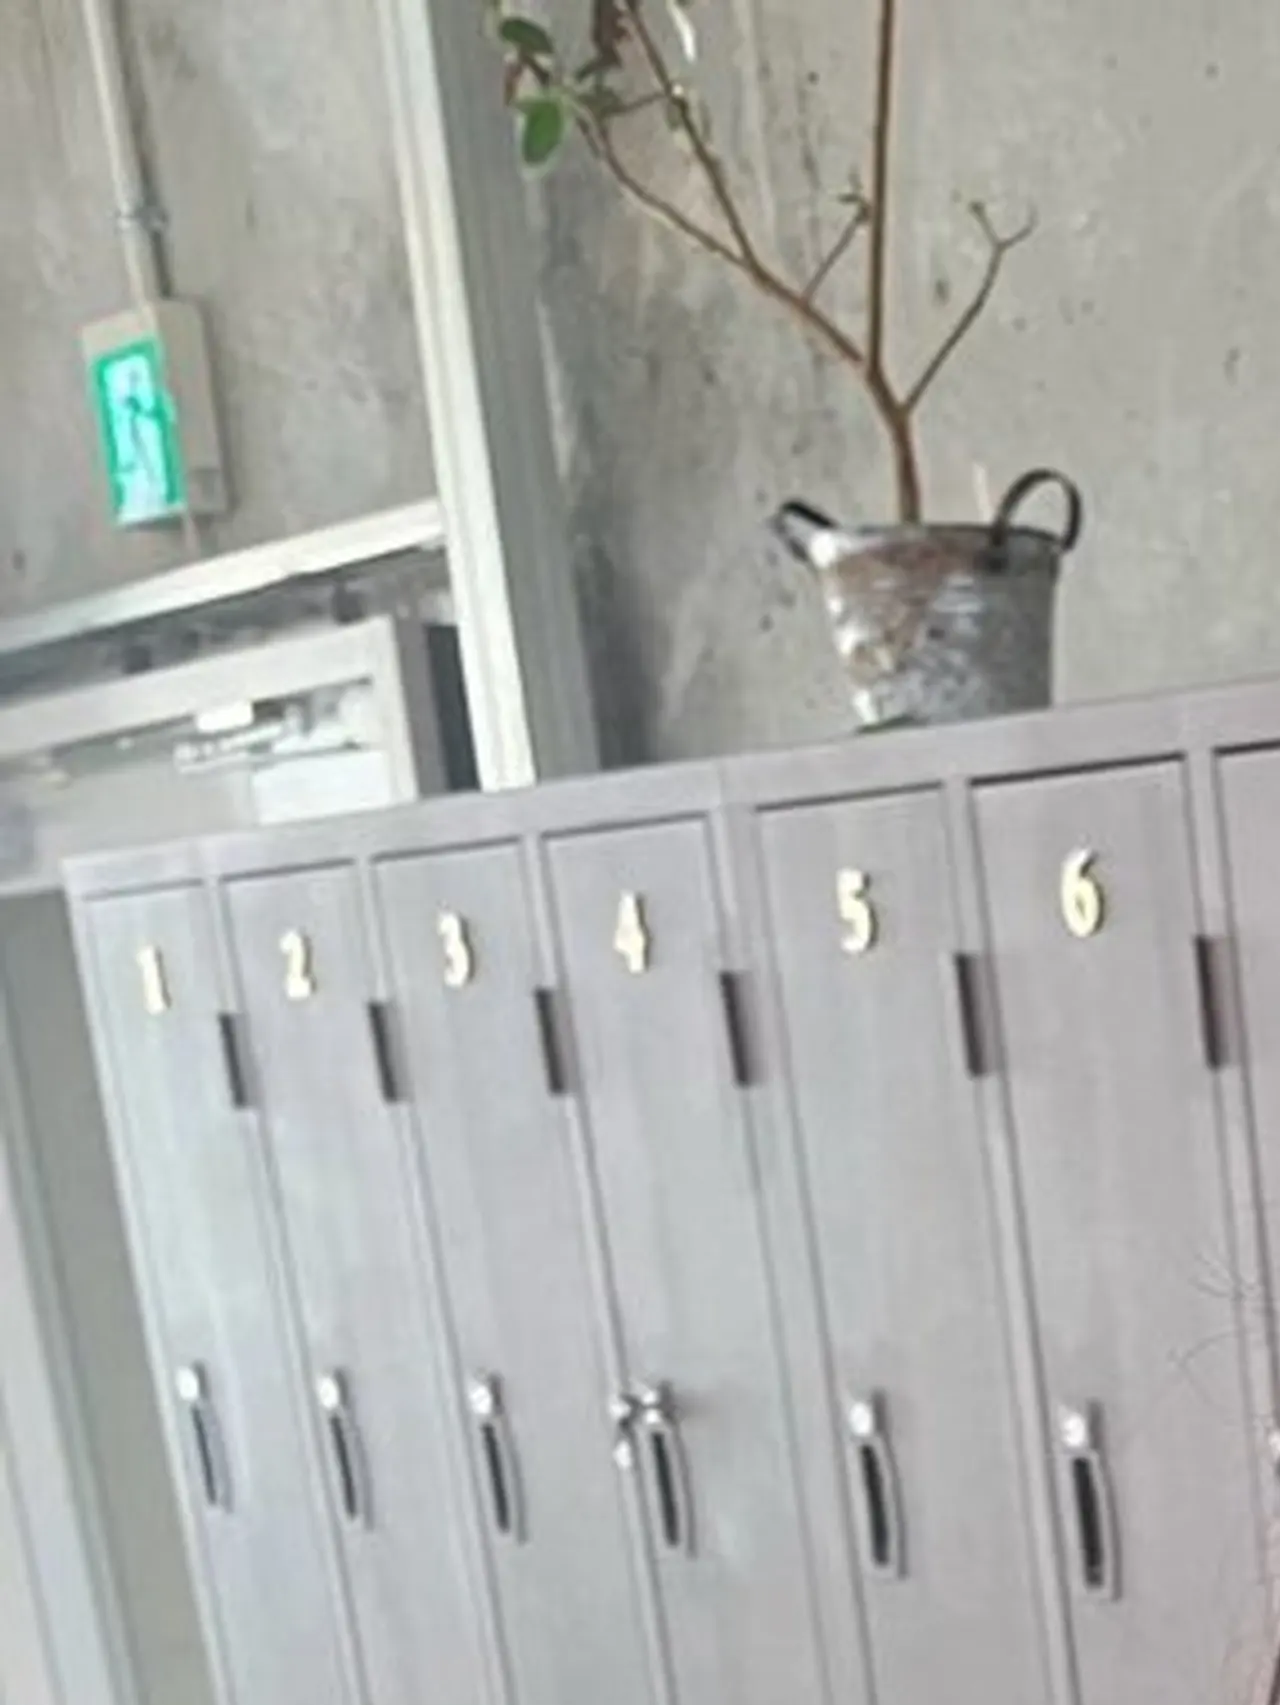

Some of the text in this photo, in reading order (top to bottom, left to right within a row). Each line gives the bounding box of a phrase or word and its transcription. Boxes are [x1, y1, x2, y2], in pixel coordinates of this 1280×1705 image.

[612, 889, 648, 974] 4
[835, 867, 873, 954] 5
[1059, 848, 1102, 938] 6
[134, 944, 168, 1015] 1
[278, 929, 313, 1000] 2
[437, 912, 471, 988] 3
